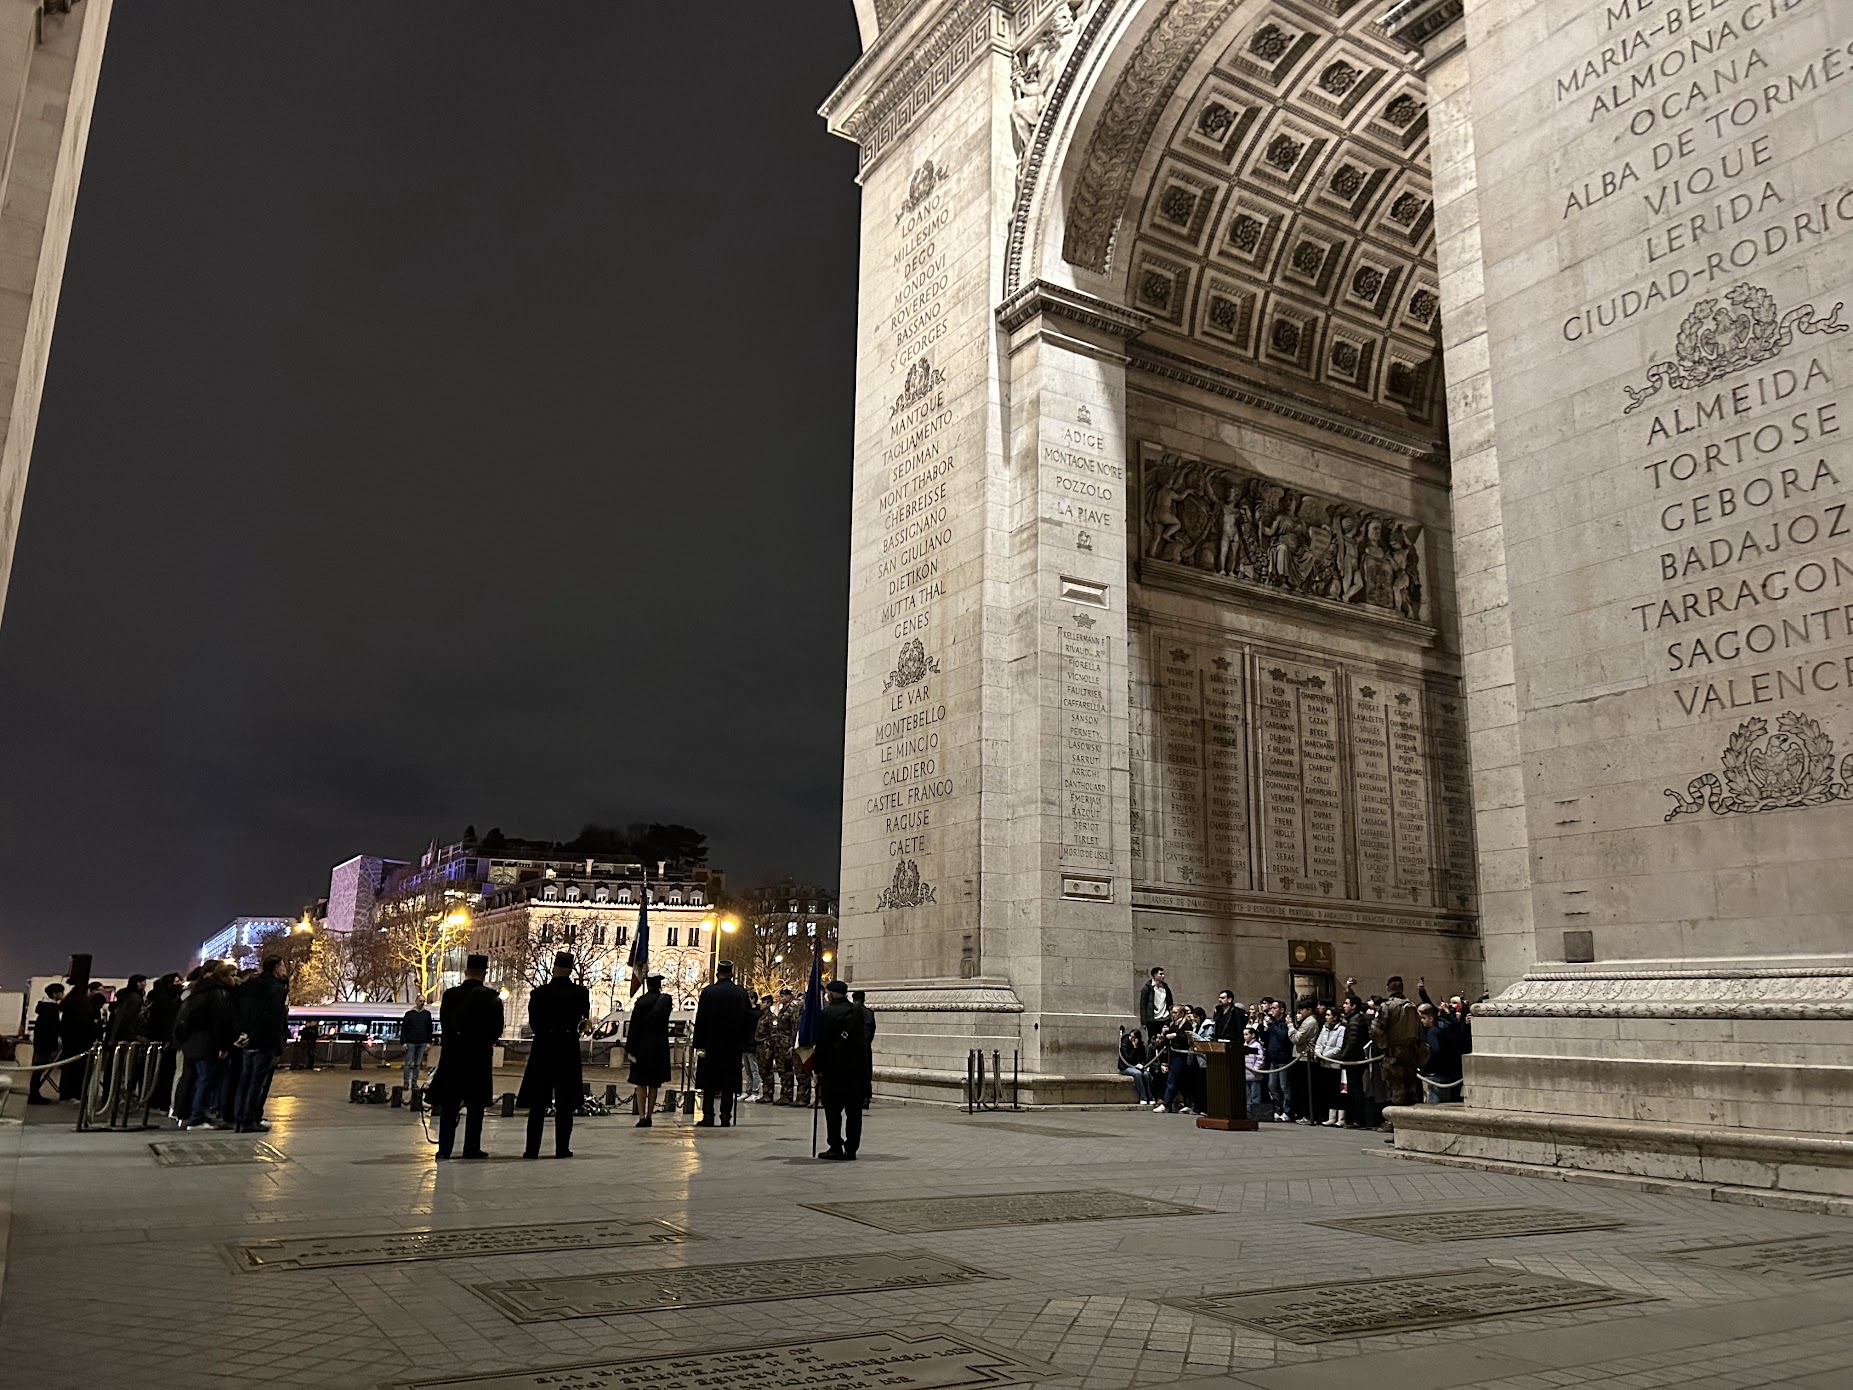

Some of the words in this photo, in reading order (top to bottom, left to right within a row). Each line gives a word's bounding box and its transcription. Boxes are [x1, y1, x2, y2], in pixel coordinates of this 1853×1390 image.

[1630, 48, 1768, 135] OCANA
[1562, 162, 1640, 219] ALBA
[1652, 128, 1695, 171] DE
[1644, 135, 1772, 215] VIQUE
[902, 195, 940, 238] LOANO
[1647, 182, 1784, 263] LERIDA
[894, 209, 949, 267] MILLESIMO
[904, 243, 935, 278] DEGO
[894, 253, 946, 308] MONDOVI
[891, 275, 948, 331] ROVEREDO
[897, 303, 940, 346] BASSANO
[900, 319, 947, 366] GEORGES
[891, 391, 943, 439] MANTOUE
[1647, 358, 1830, 446] ALMEIDA
[882, 410, 952, 466] TAGLIAMENTO
[1064, 428, 1104, 450] ADIGE
[1644, 403, 1840, 489] TORTOSE
[893, 441, 939, 482] SEDIMAN
[1045, 448, 1095, 472] MONTAGNE
[1097, 464, 1122, 480] NOIRE
[880, 482, 909, 512] MONT
[912, 456, 954, 492] THABOR
[1056, 476, 1112, 500] POZZOLO
[1661, 459, 1840, 531] GEBORA
[885, 483, 946, 529] CHEBREISSE
[1058, 502, 1073, 517] LA
[1078, 507, 1110, 526] PIAVE
[884, 507, 946, 553] BASSIGNANO
[1660, 504, 1850, 581] BADAJOZ
[878, 557, 896, 578] SAN
[901, 529, 951, 565] GIULIANO
[890, 559, 938, 595] DIETIKON
[882, 595, 915, 622] MUTTA
[919, 581, 946, 604] THAL
[895, 611, 929, 638] GENES
[1063, 631, 1099, 644] KELLERMANN
[1067, 672, 1099, 684] VIGNOLLE
[1068, 659, 1100, 671] FIORELLA
[892, 695, 902, 712] LE
[908, 686, 929, 705] VAR
[1067, 685, 1102, 699] FAULTRIER
[876, 706, 945, 742] MONTEBELLO
[1071, 713, 1098, 724] SANSON
[882, 746, 892, 763] LE
[897, 733, 938, 758] MINCIO
[1068, 740, 1101, 752] LASOWSKI
[1072, 754, 1098, 764] SARRUT
[883, 759, 935, 786] CALDIERO
[1064, 779, 1105, 792] DANTHOUARD
[1071, 767, 1099, 778] ARRIGHI
[867, 792, 903, 813] CASTEL
[908, 779, 953, 804] FRANCO
[886, 810, 929, 833] RAGUSE
[1071, 806, 1099, 818] RAZOUT
[1073, 821, 1098, 831] DERIOT
[890, 836, 924, 856] GAETE
[1073, 834, 1098, 845] TIRLET
[668, 1360, 702, 1368] DE
[934, 1348, 974, 1356] QUI
[534, 1375, 583, 1384] VIE
[592, 1365, 660, 1376] LEUR
[620, 1363, 759, 1384] NOVEMBRE
[862, 1368, 893, 1376] ET
[879, 1376, 915, 1385] EN
